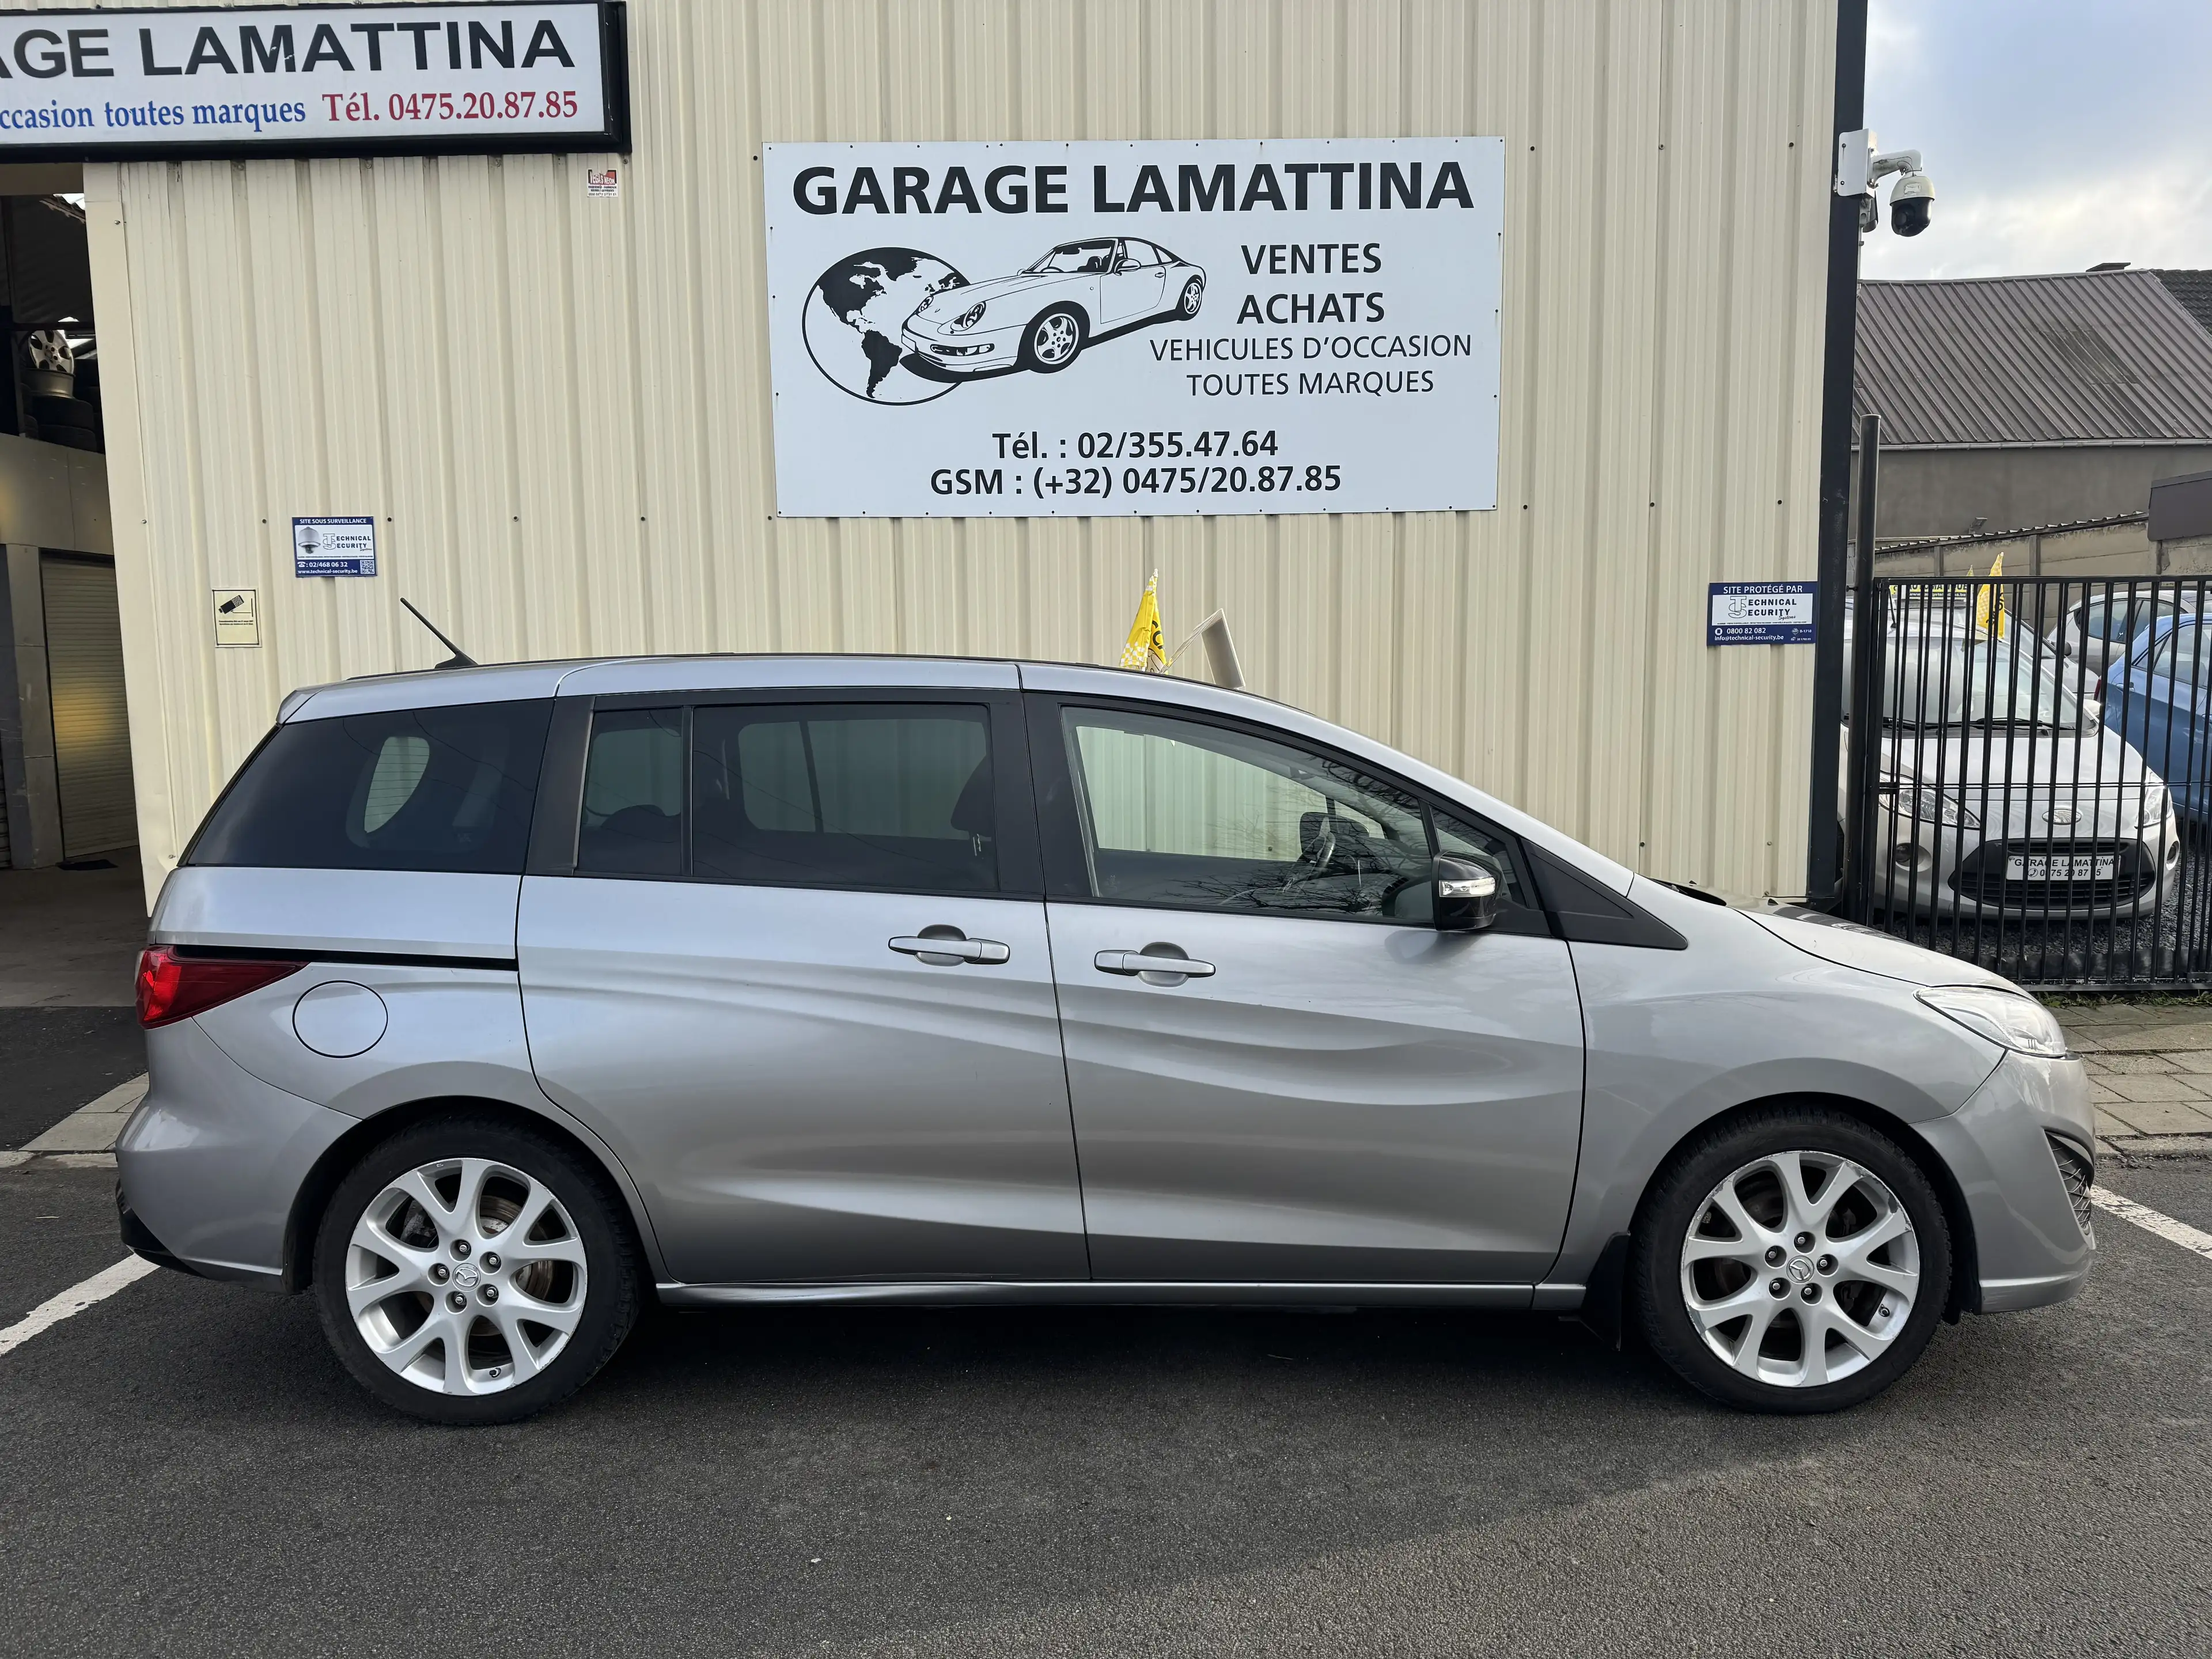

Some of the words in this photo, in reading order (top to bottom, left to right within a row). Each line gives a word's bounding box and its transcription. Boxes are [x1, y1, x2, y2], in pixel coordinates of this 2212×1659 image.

[0, 29, 114, 78] GE
[139, 20, 575, 75] LAMATTINA
[104, 101, 184, 127] toutes
[192, 103, 305, 132] marques
[322, 92, 379, 122] Tél.
[389, 91, 577, 120] 0475.20.87.85
[793, 165, 1068, 214] GARAGE
[1094, 162, 1474, 212] LAMATTINA
[1241, 243, 1381, 274] VENTES
[1237, 293, 1384, 324] ACHATS
[1150, 338, 1293, 361] VEHICULES
[1187, 373, 1289, 396] TOUTES
[1300, 370, 1434, 396] MARQUES
[993, 431, 1047, 459] Tél.
[1078, 431, 1278, 459] 02/355.47.64
[931, 469, 1003, 495] GSM
[1034, 467, 1112, 499] (+32)
[1123, 465, 1340, 494] 0475/20.87.85
[1744, 584, 1784, 593] PROTÉGÉ
